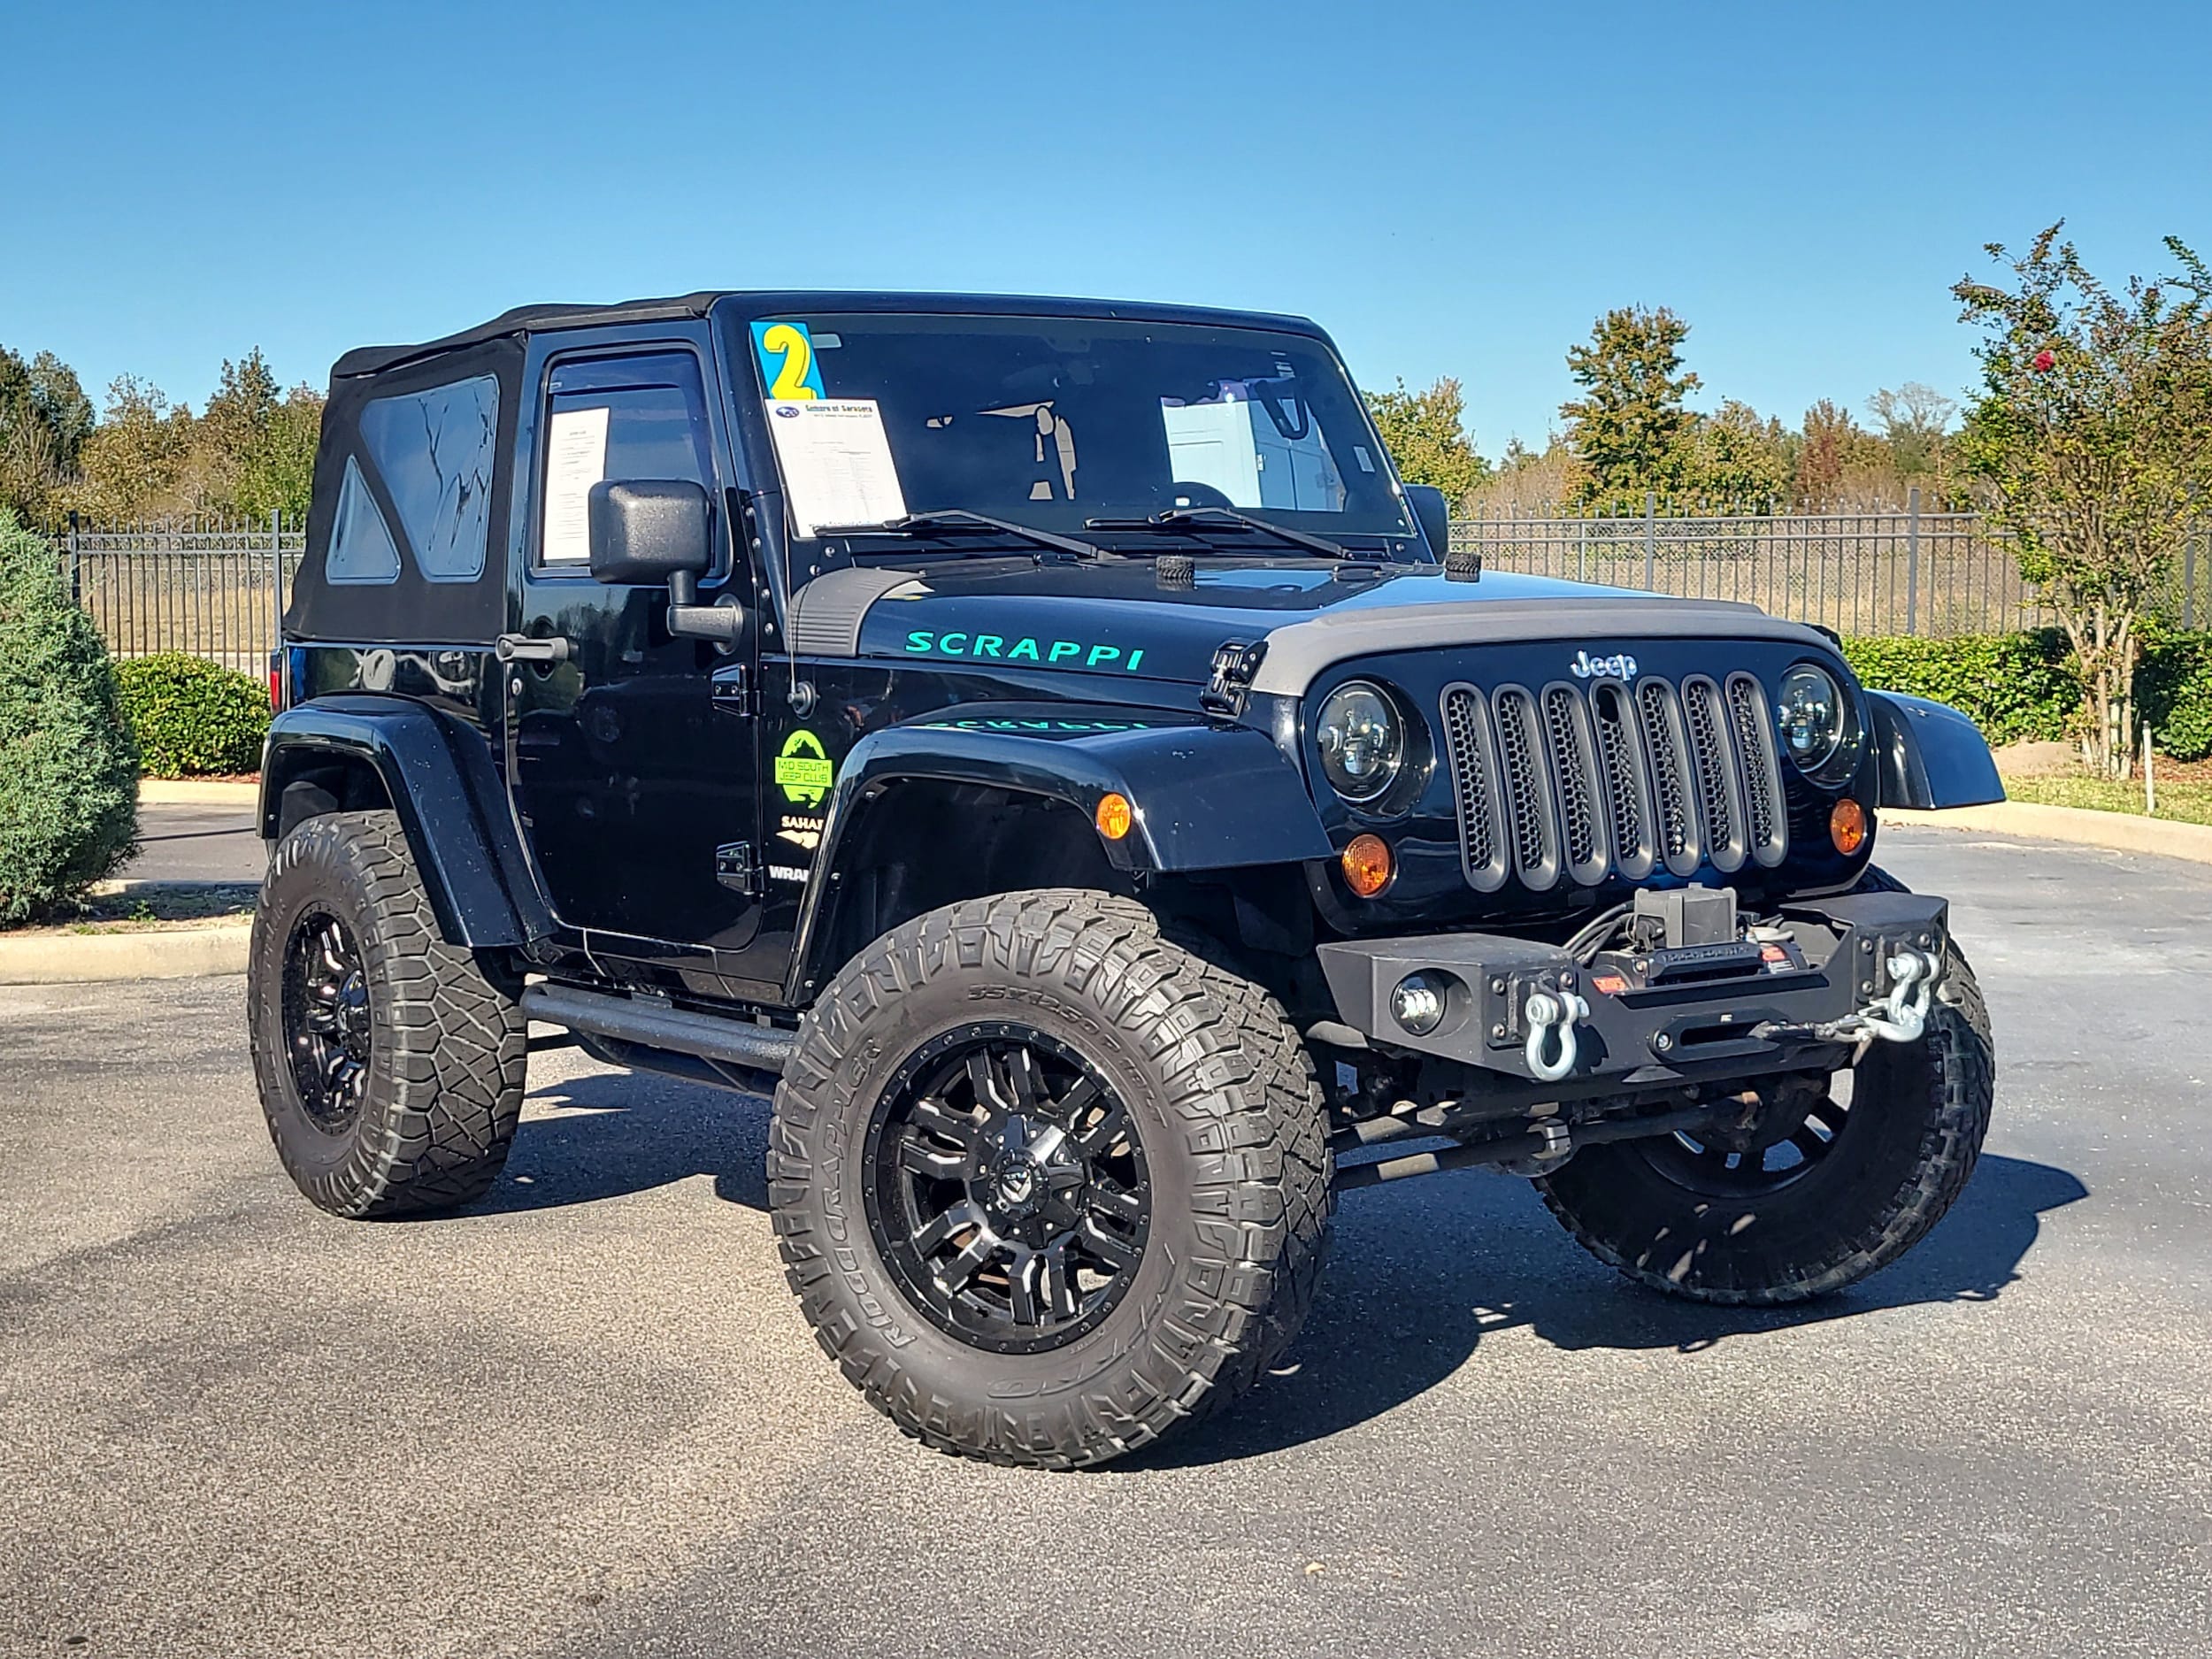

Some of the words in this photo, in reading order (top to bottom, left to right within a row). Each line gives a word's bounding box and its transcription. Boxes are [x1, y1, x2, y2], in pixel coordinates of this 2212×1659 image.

[764, 324, 818, 400] 2
[905, 631, 1144, 671] SCRAPPI
[1570, 649, 1637, 681] Jeep
[797, 762, 829, 772] SOUTH
